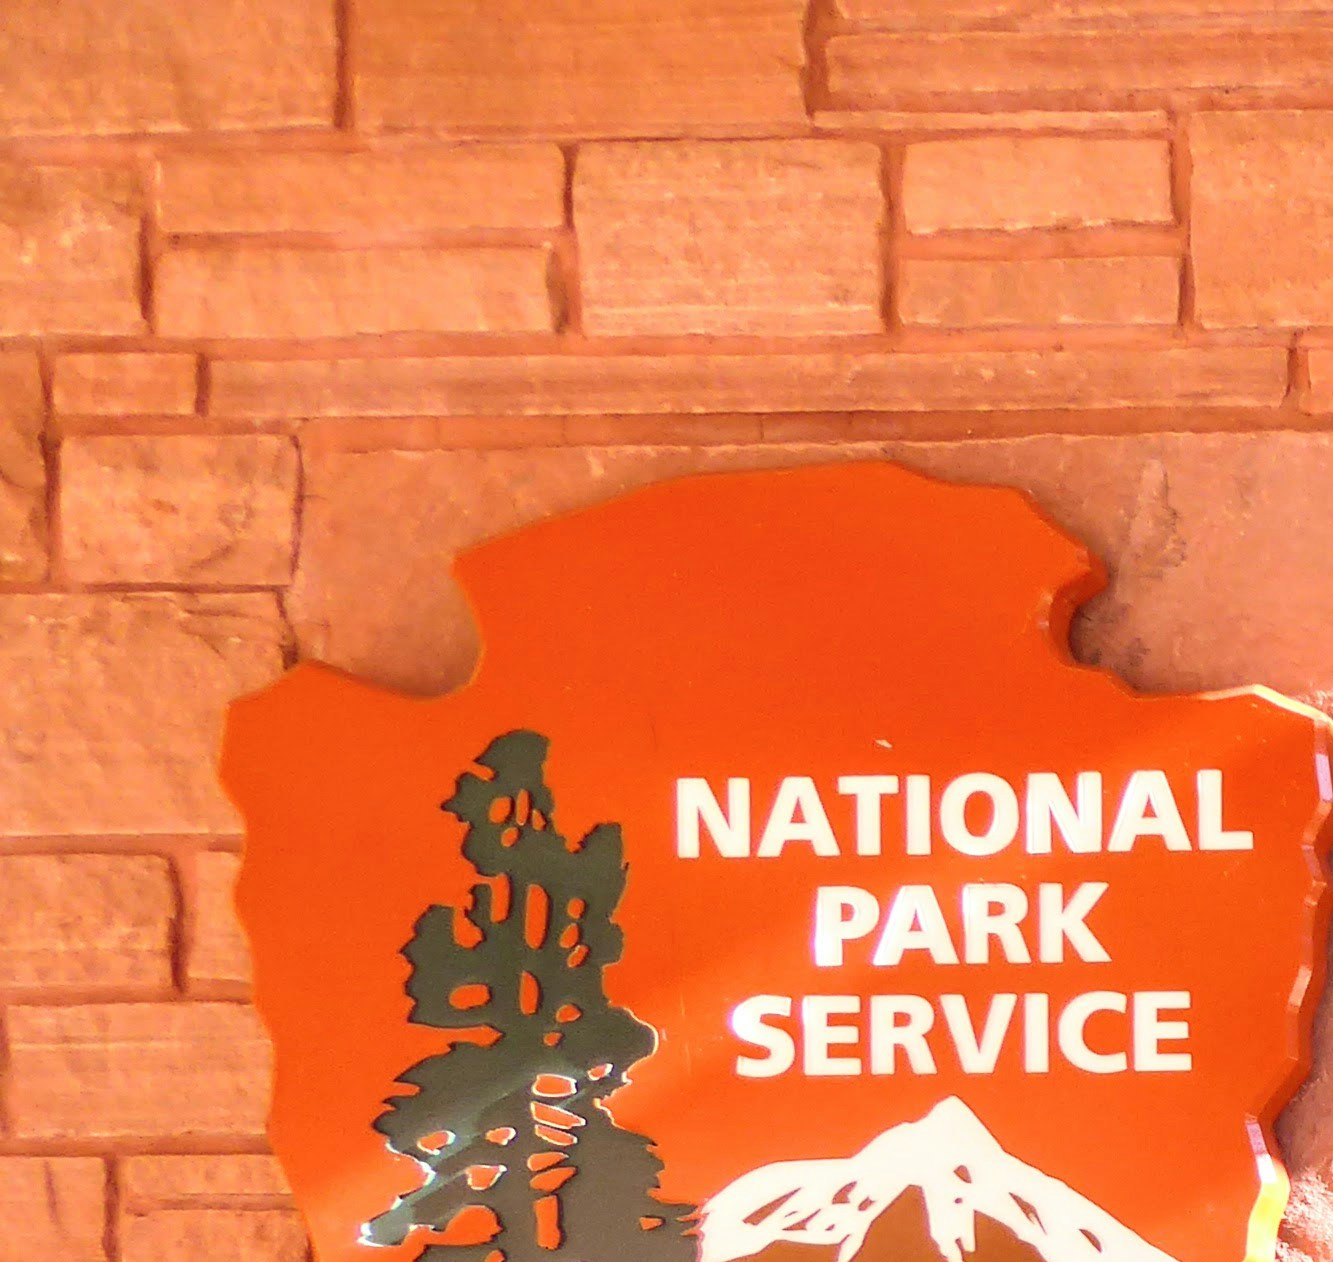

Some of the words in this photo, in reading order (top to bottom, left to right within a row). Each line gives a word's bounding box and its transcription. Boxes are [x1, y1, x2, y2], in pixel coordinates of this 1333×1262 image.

[676, 770, 1254, 858] NATIONAL
[813, 882, 1112, 967] PARK
[729, 991, 1192, 1078] SERVICE
